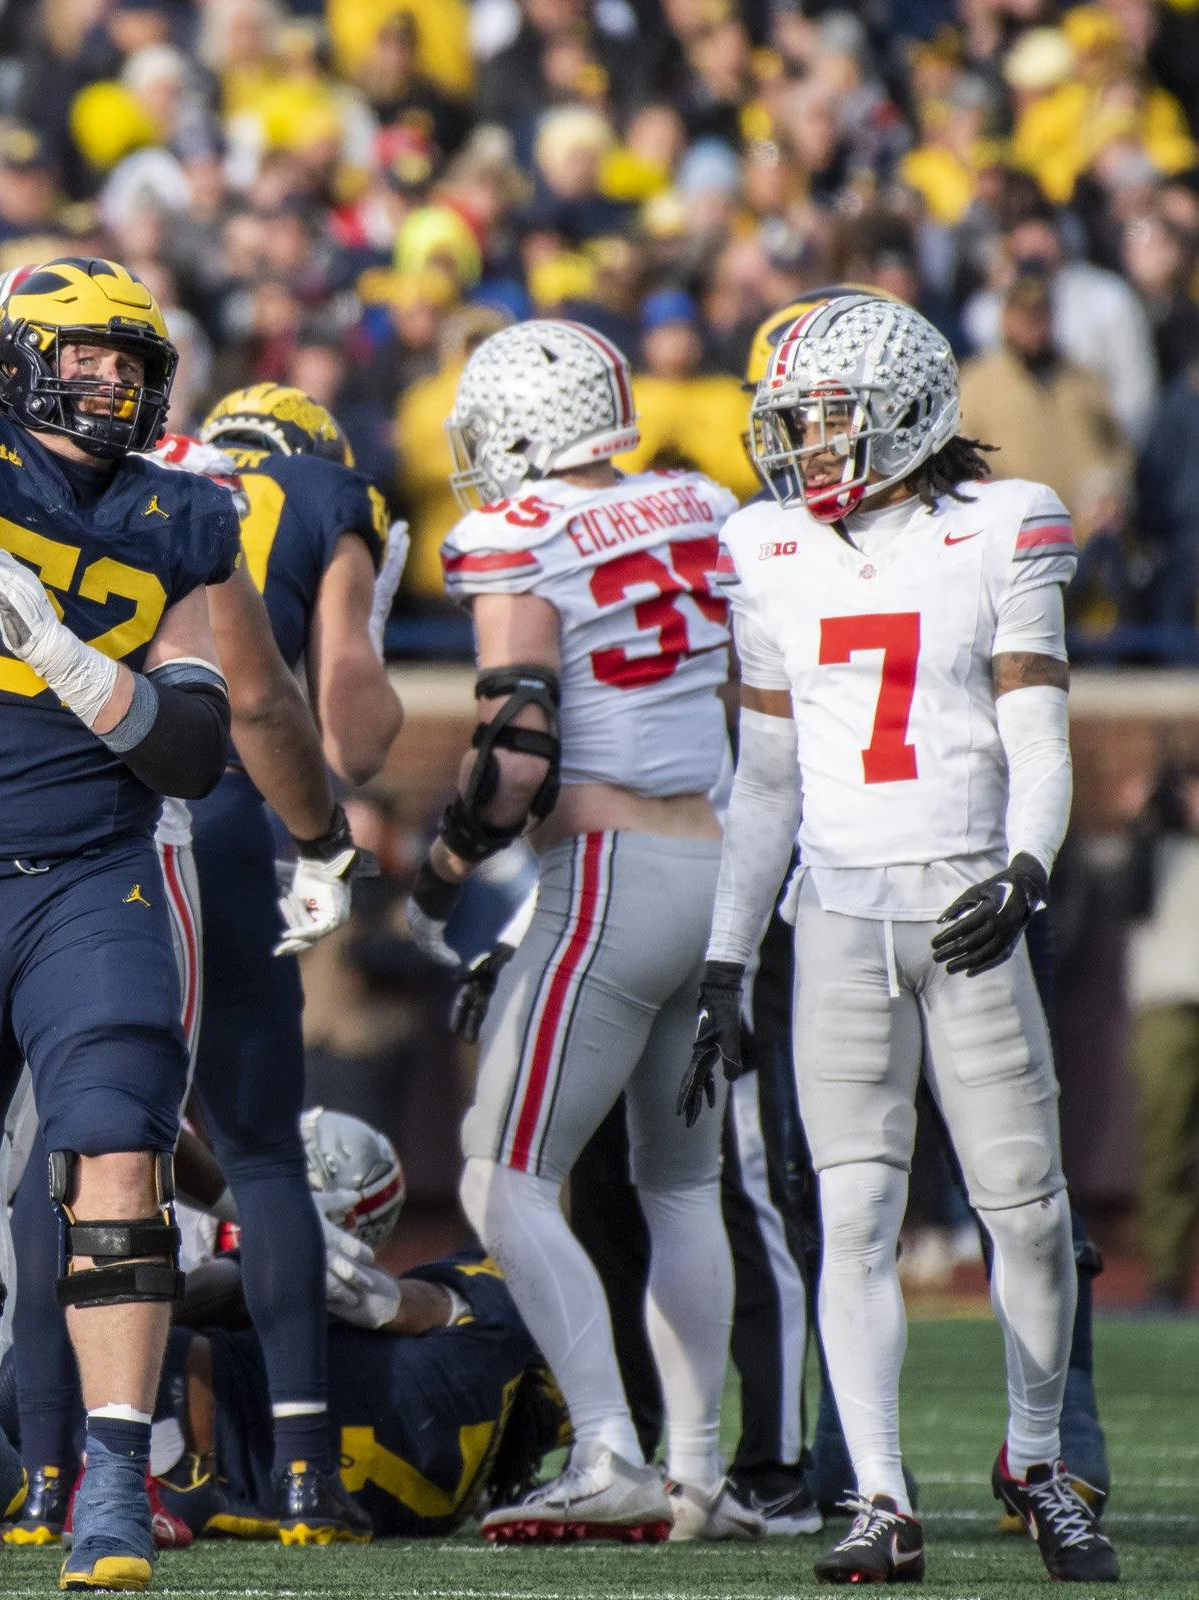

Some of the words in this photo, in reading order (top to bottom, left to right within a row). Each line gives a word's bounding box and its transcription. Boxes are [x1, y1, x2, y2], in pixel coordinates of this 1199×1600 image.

[566, 486, 716, 557] EICHENBERG
[589, 533, 730, 705] 35
[818, 611, 922, 785] 7
